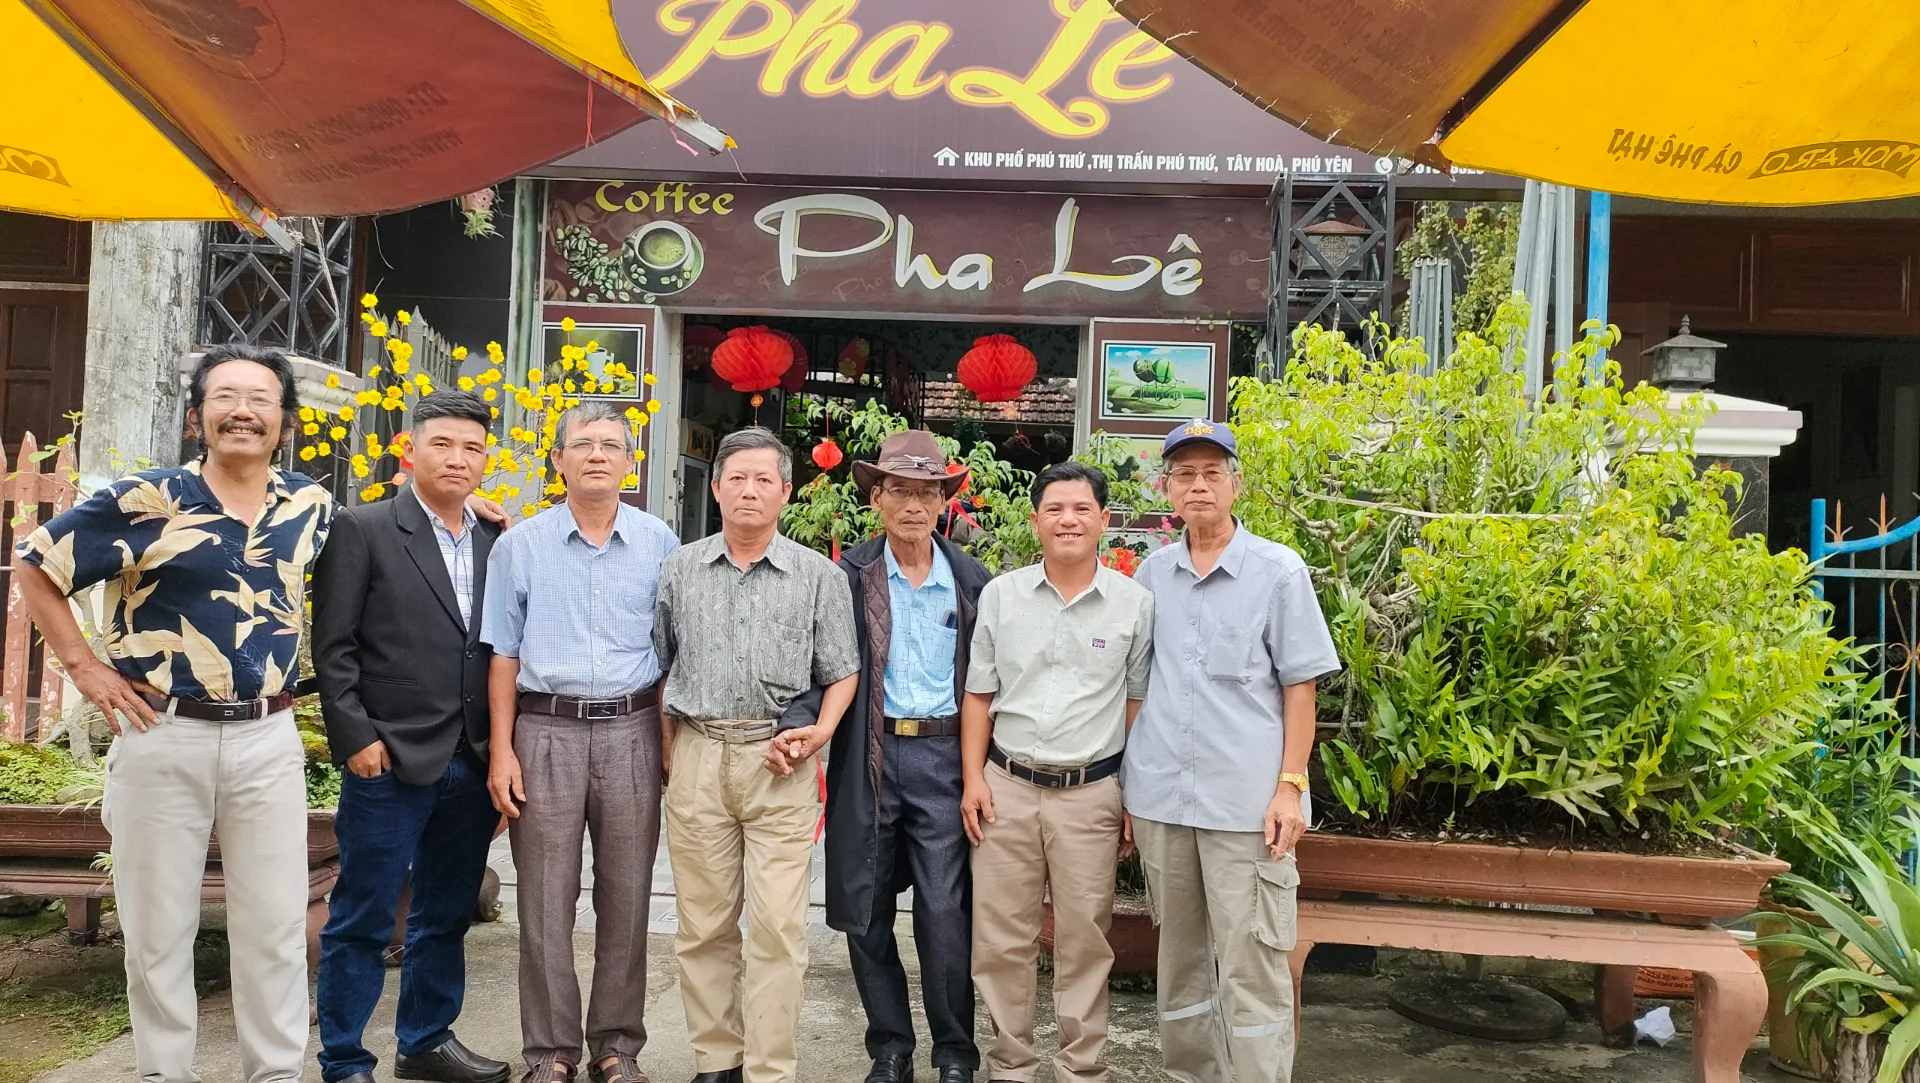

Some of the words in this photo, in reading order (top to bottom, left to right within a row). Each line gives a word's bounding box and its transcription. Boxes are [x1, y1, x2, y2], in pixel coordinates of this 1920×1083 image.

[648, 0, 951, 97] Pha
[964, 151, 993, 168] KHU
[995, 148, 1025, 168] PHỐ
[1027, 150, 1055, 169] PHÚ
[1116, 150, 1153, 171] TRẤN
[1156, 152, 1185, 171] PHÚ
[1188, 153, 1219, 174] THỨ,
[1226, 153, 1252, 173] TÂY
[1255, 154, 1289, 174] HOÀ,
[1292, 154, 1321, 173] PHÚ
[1324, 154, 1352, 173] YÊN
[594, 181, 735, 216] Coffee
[754, 193, 994, 291] Pha
[1022, 197, 1203, 297] Lê
